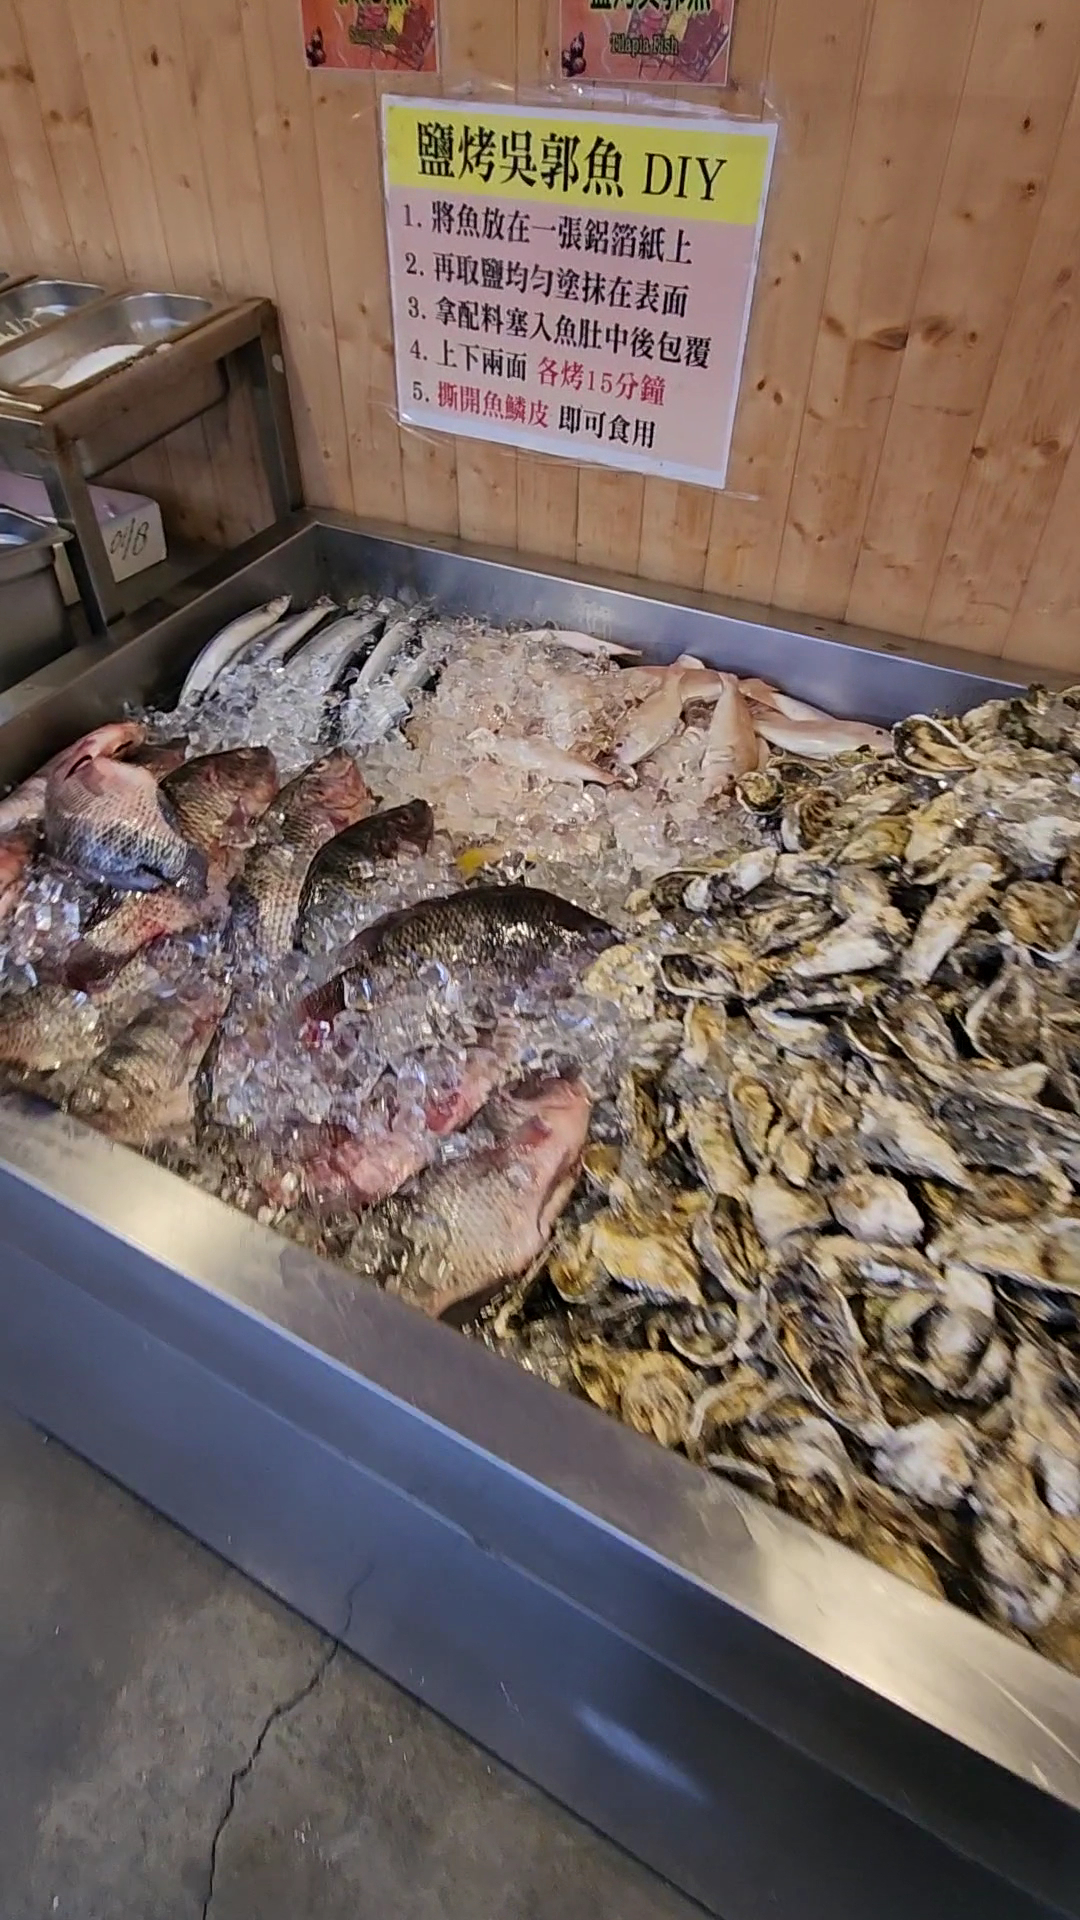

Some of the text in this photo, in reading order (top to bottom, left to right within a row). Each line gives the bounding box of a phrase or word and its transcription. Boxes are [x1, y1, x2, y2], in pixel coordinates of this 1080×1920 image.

[610, 33, 679, 57] Tilapia Fish
[417, 120, 728, 202] 鹽烤吳郭魚 DIY
[403, 200, 692, 265] 1. 將魚放在一張鋁箔紙上
[405, 252, 689, 318] 2. 再取鹽均勻塗抹在表面
[407, 296, 712, 369] 3. 拿配料塞入魚肚中後包覆
[409, 340, 666, 407] 4. 上下兩面 各烤15分鐘
[412, 380, 656, 449] 5. 撕開魚鱗皮 即可食用
